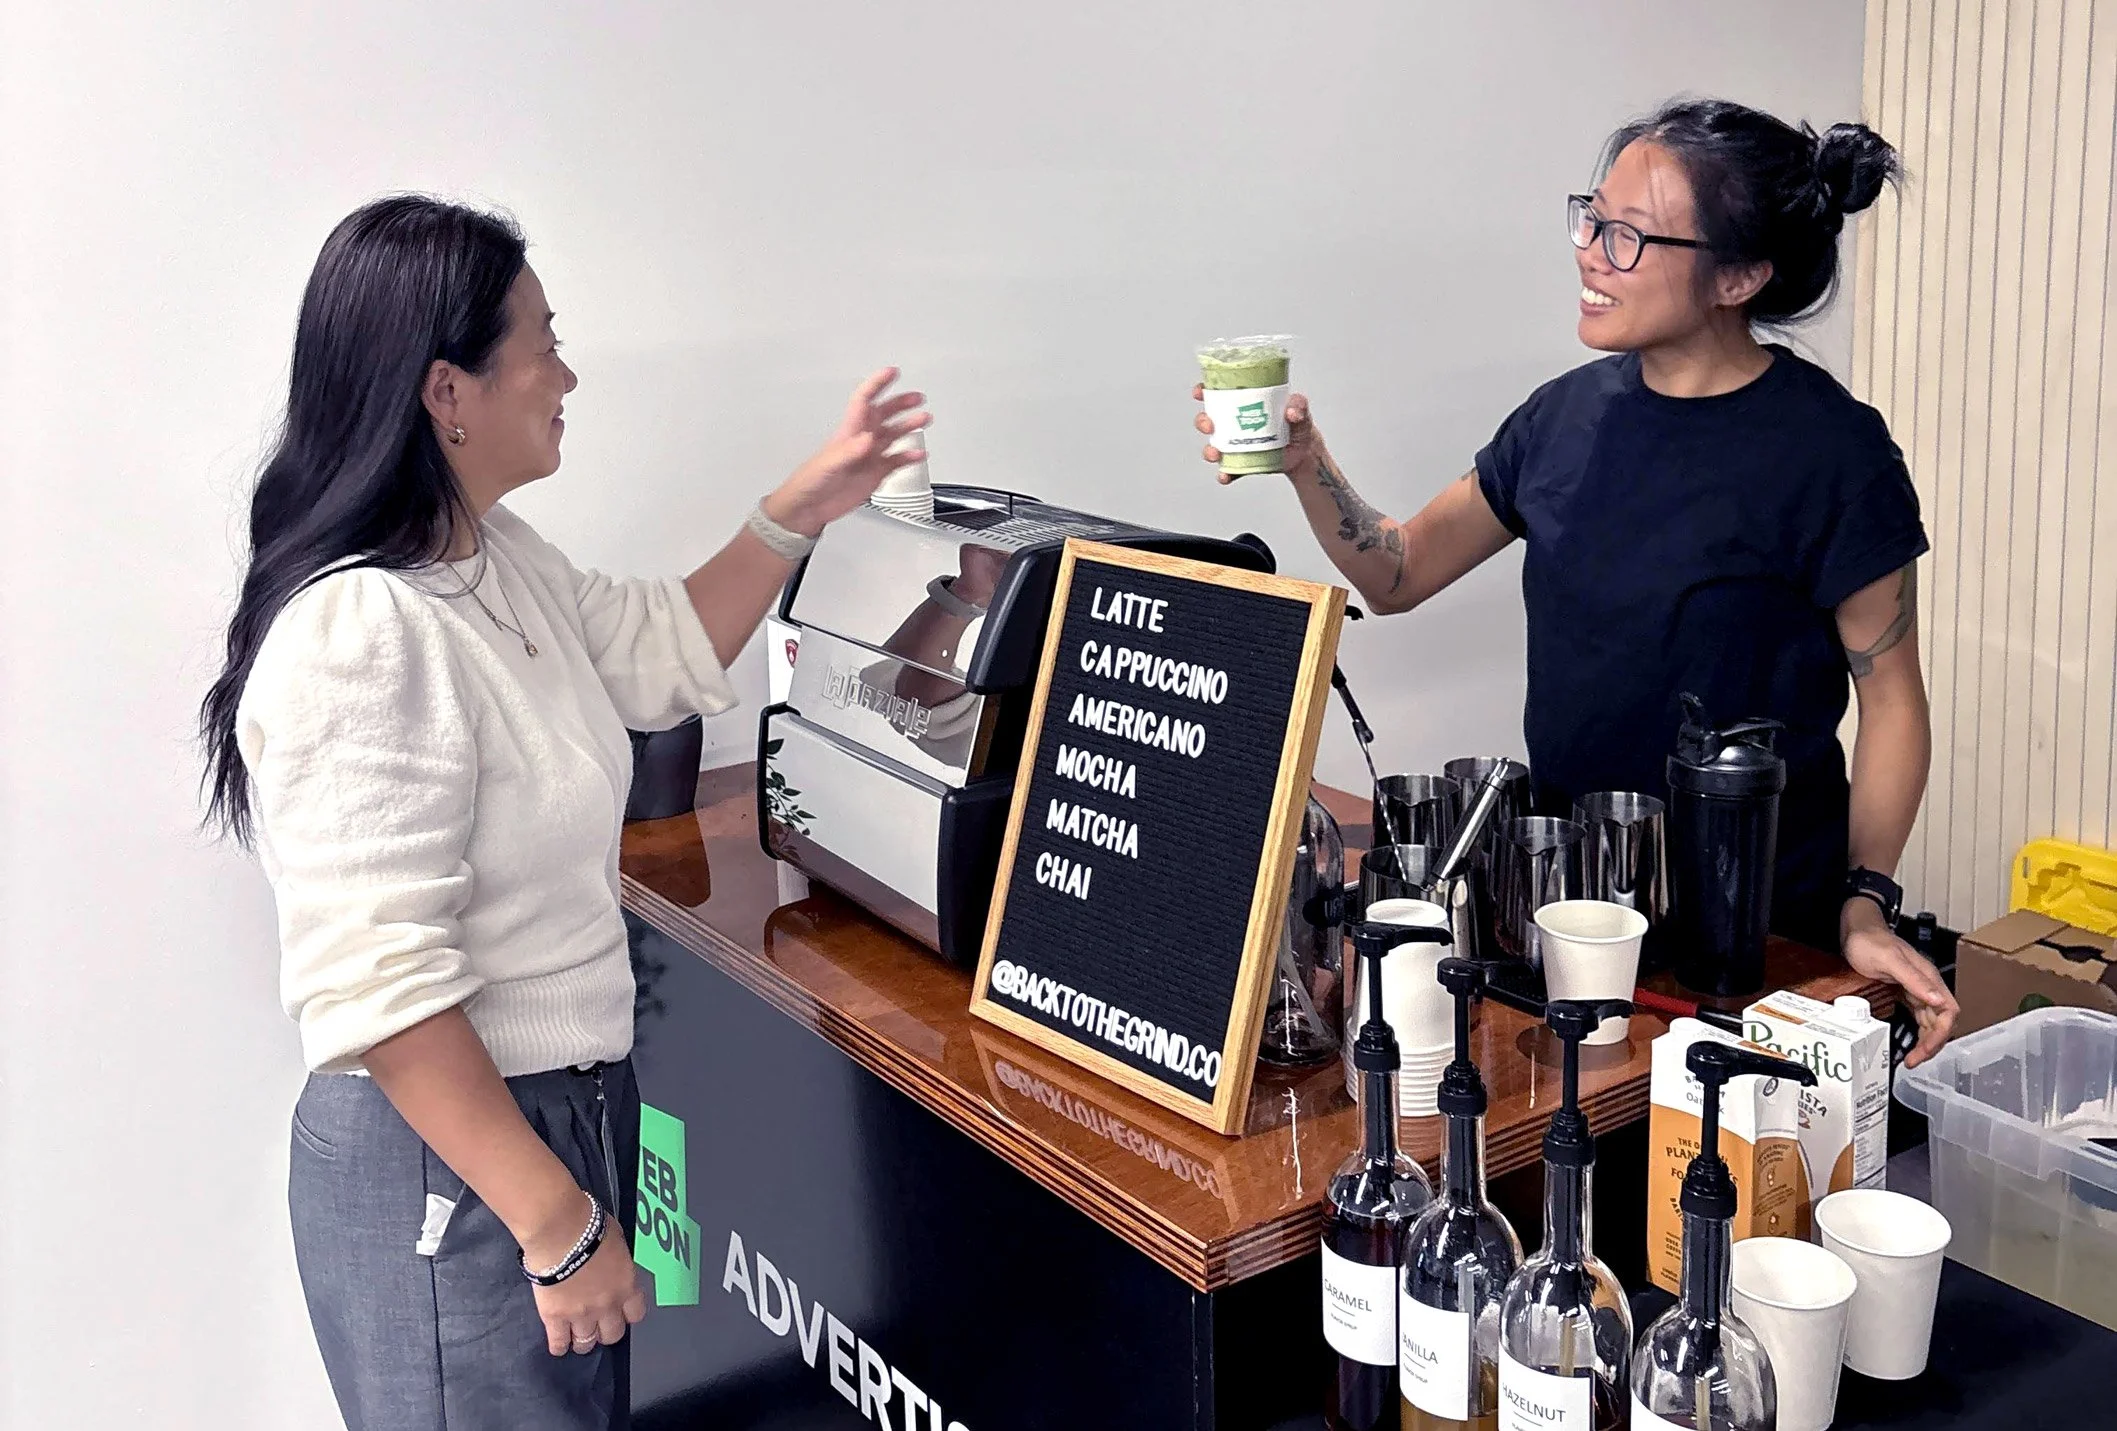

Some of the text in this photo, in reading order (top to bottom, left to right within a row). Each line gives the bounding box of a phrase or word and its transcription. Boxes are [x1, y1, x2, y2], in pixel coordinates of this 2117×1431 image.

[1090, 587, 1169, 633] LATTE
[1080, 640, 1228, 705] CAPPUCCINO
[1068, 693, 1206, 758] AMERICANO
[1056, 744, 1136, 799] MOCHA
[1046, 798, 1138, 859] MATCHA
[1036, 851, 1092, 900] CHAI
[991, 960, 1221, 1087] @BACKTOTHEGRIND.CO
[1800, 1089, 1828, 1117] ISTA
[641, 1146, 678, 1214] EB
[637, 1188, 691, 1271] OON
[722, 1230, 971, 1431] ADVERT
[1402, 1332, 1438, 1365] ANILLA
[1502, 1382, 1567, 1423] HAZELNUT
